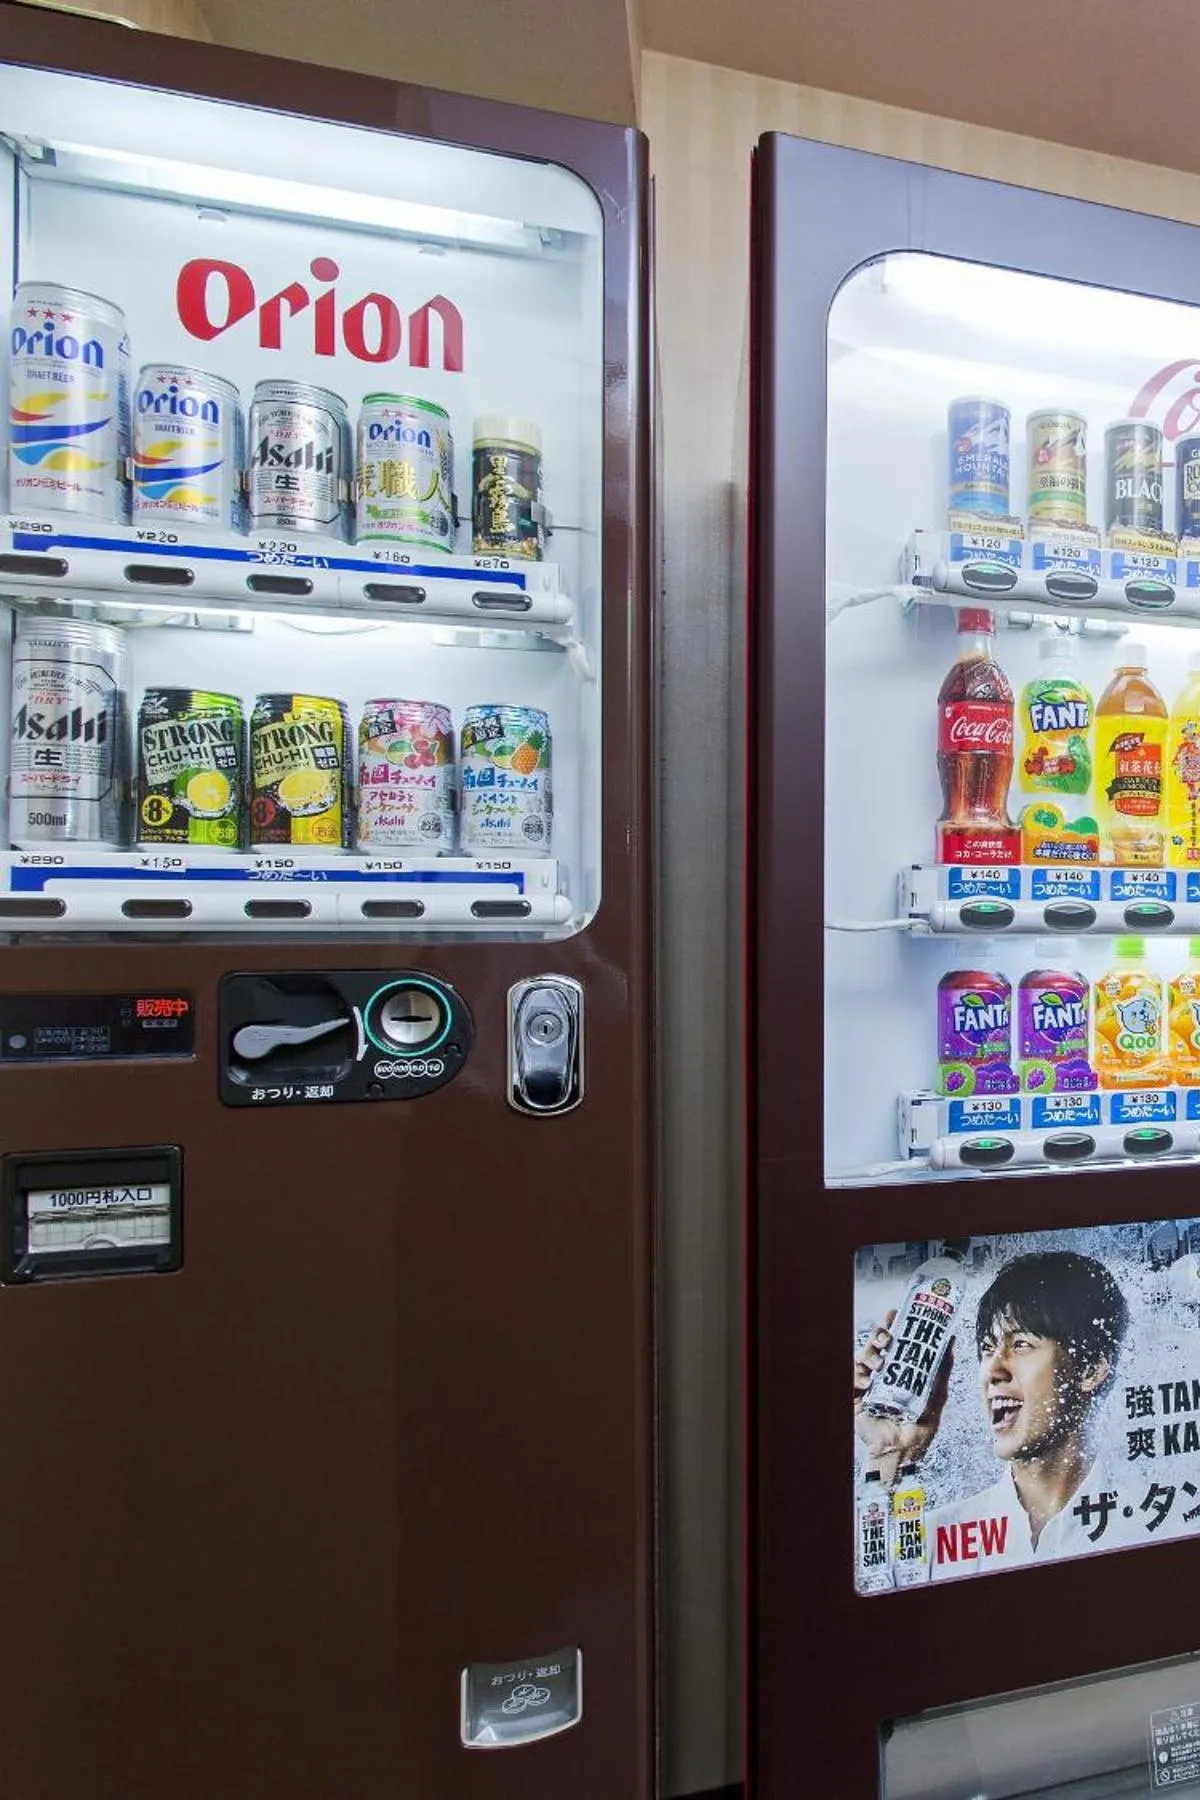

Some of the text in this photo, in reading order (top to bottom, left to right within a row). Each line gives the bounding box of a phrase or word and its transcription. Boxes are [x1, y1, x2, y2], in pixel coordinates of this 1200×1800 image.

[176, 256, 464, 373] Orion
[12, 321, 104, 369] Orion
[137, 385, 219, 425] Orion
[369, 420, 431, 449] Orion
[252, 436, 334, 475] Asahi
[275, 474, 301, 491] 生
[8, 519, 54, 533] ¥290
[135, 529, 179, 544] ¥220
[970, 538, 1001, 549] ¥120
[257, 540, 298, 554] ¥220
[372, 550, 411, 564] ¥160
[1132, 556, 1160, 567] ¥120
[13, 703, 108, 745] Asahi
[951, 716, 1012, 745] Coca-Cola
[143, 718, 234, 753] STRONG
[253, 721, 334, 756] STRONG
[34, 748, 64, 767] 生
[147, 745, 210, 767] CHU-HI
[255, 748, 309, 770] CHU-HI
[27, 811, 68, 827] 500ml
[374, 815, 405, 826] Asahi
[480, 817, 512, 828] Asahi
[20, 855, 65, 866] ¥290
[141, 857, 183, 869] ¥150
[255, 859, 294, 869] ¥150
[365, 861, 403, 870] ¥150
[476, 861, 512, 870] ¥150
[970, 870, 1001, 880] ¥140
[1055, 871, 1084, 881] ¥140
[1131, 873, 1159, 883] ¥140
[136, 998, 189, 1017] 販売中
[1119, 1033, 1156, 1051] Qoo
[1053, 1097, 1082, 1107] ¥130
[1131, 1094, 1159, 1103] ¥130
[972, 1102, 1002, 1111] ¥130
[48, 1186, 154, 1209] 1000円札入口
[909, 1302, 952, 1328] STRONG
[902, 1316, 945, 1349] THE
[893, 1339, 937, 1373] TAN
[883, 1363, 928, 1397] SAN
[863, 1527, 885, 1540] THE
[899, 1519, 921, 1534] THE
[863, 1540, 886, 1553] TAN
[899, 1533, 922, 1547] TAN
[936, 1516, 1009, 1565] NEW
[863, 1553, 886, 1568] SAN
[899, 1547, 923, 1561] SAN
